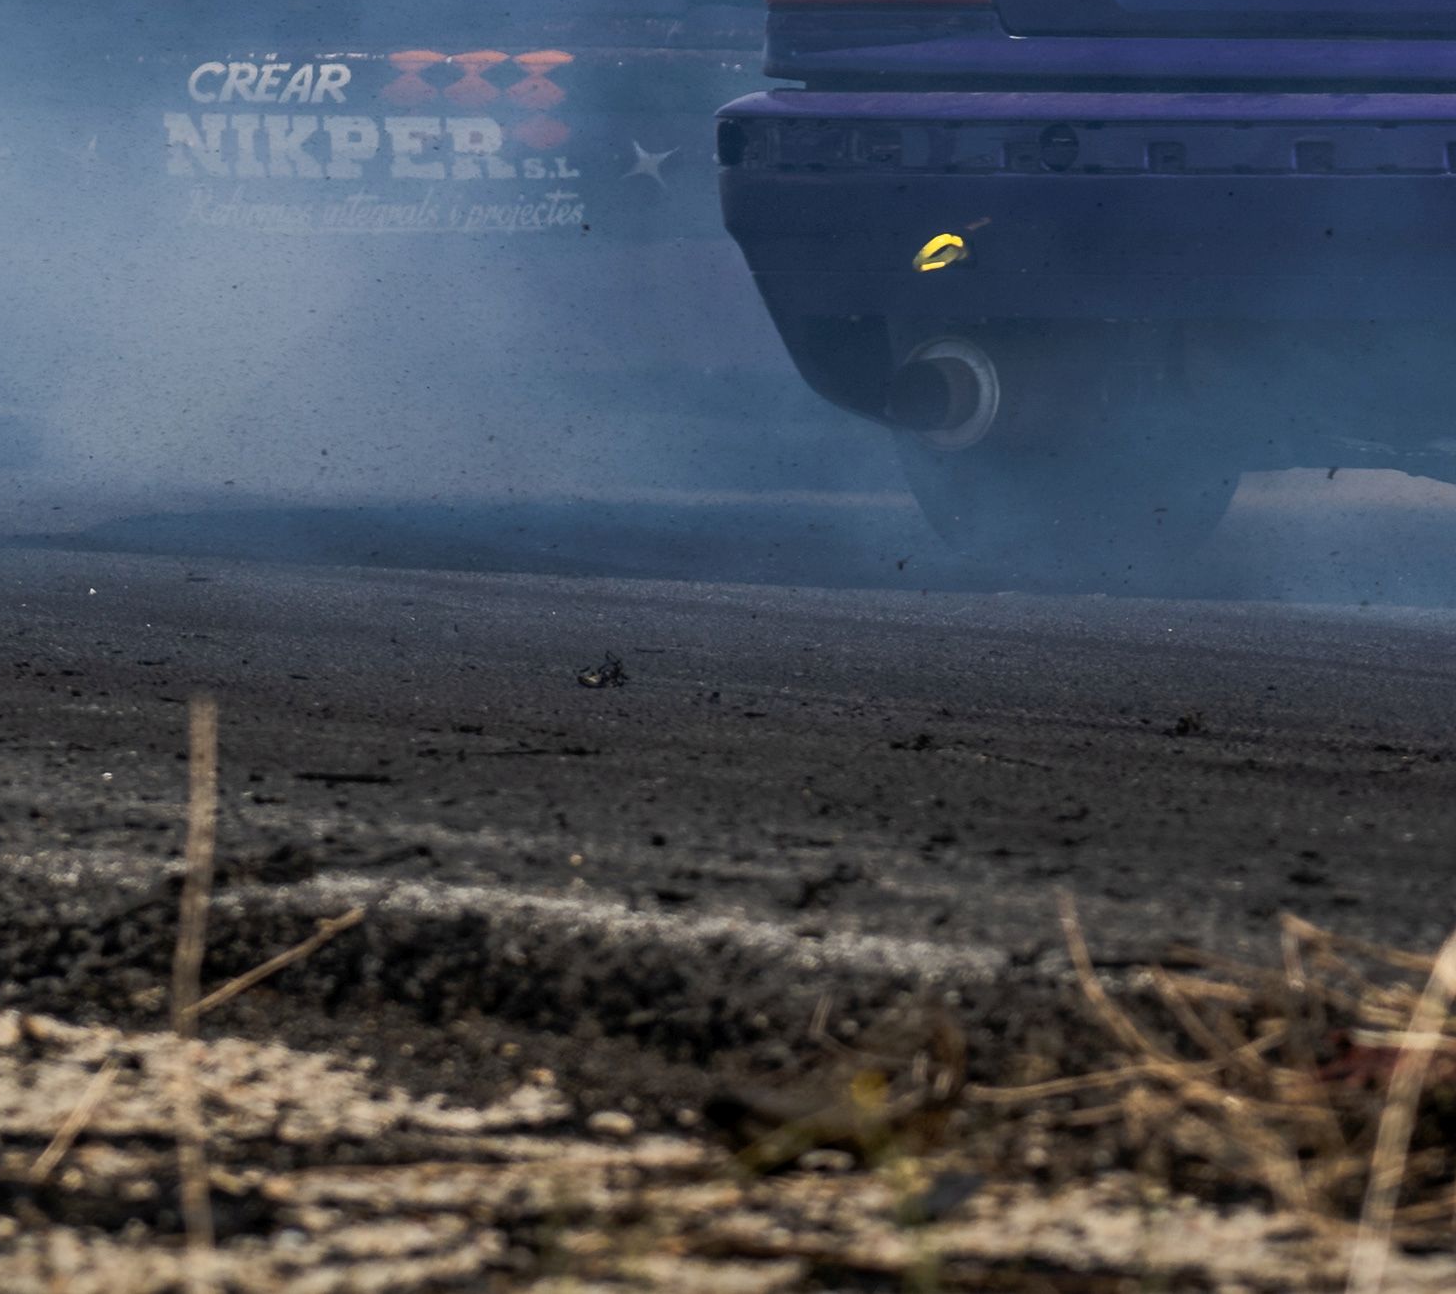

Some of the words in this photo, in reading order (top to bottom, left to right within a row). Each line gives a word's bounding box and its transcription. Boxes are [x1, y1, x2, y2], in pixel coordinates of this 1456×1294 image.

[187, 61, 352, 104] CREAR
[163, 112, 516, 180] NIKPER
[461, 190, 586, 234] projectes
